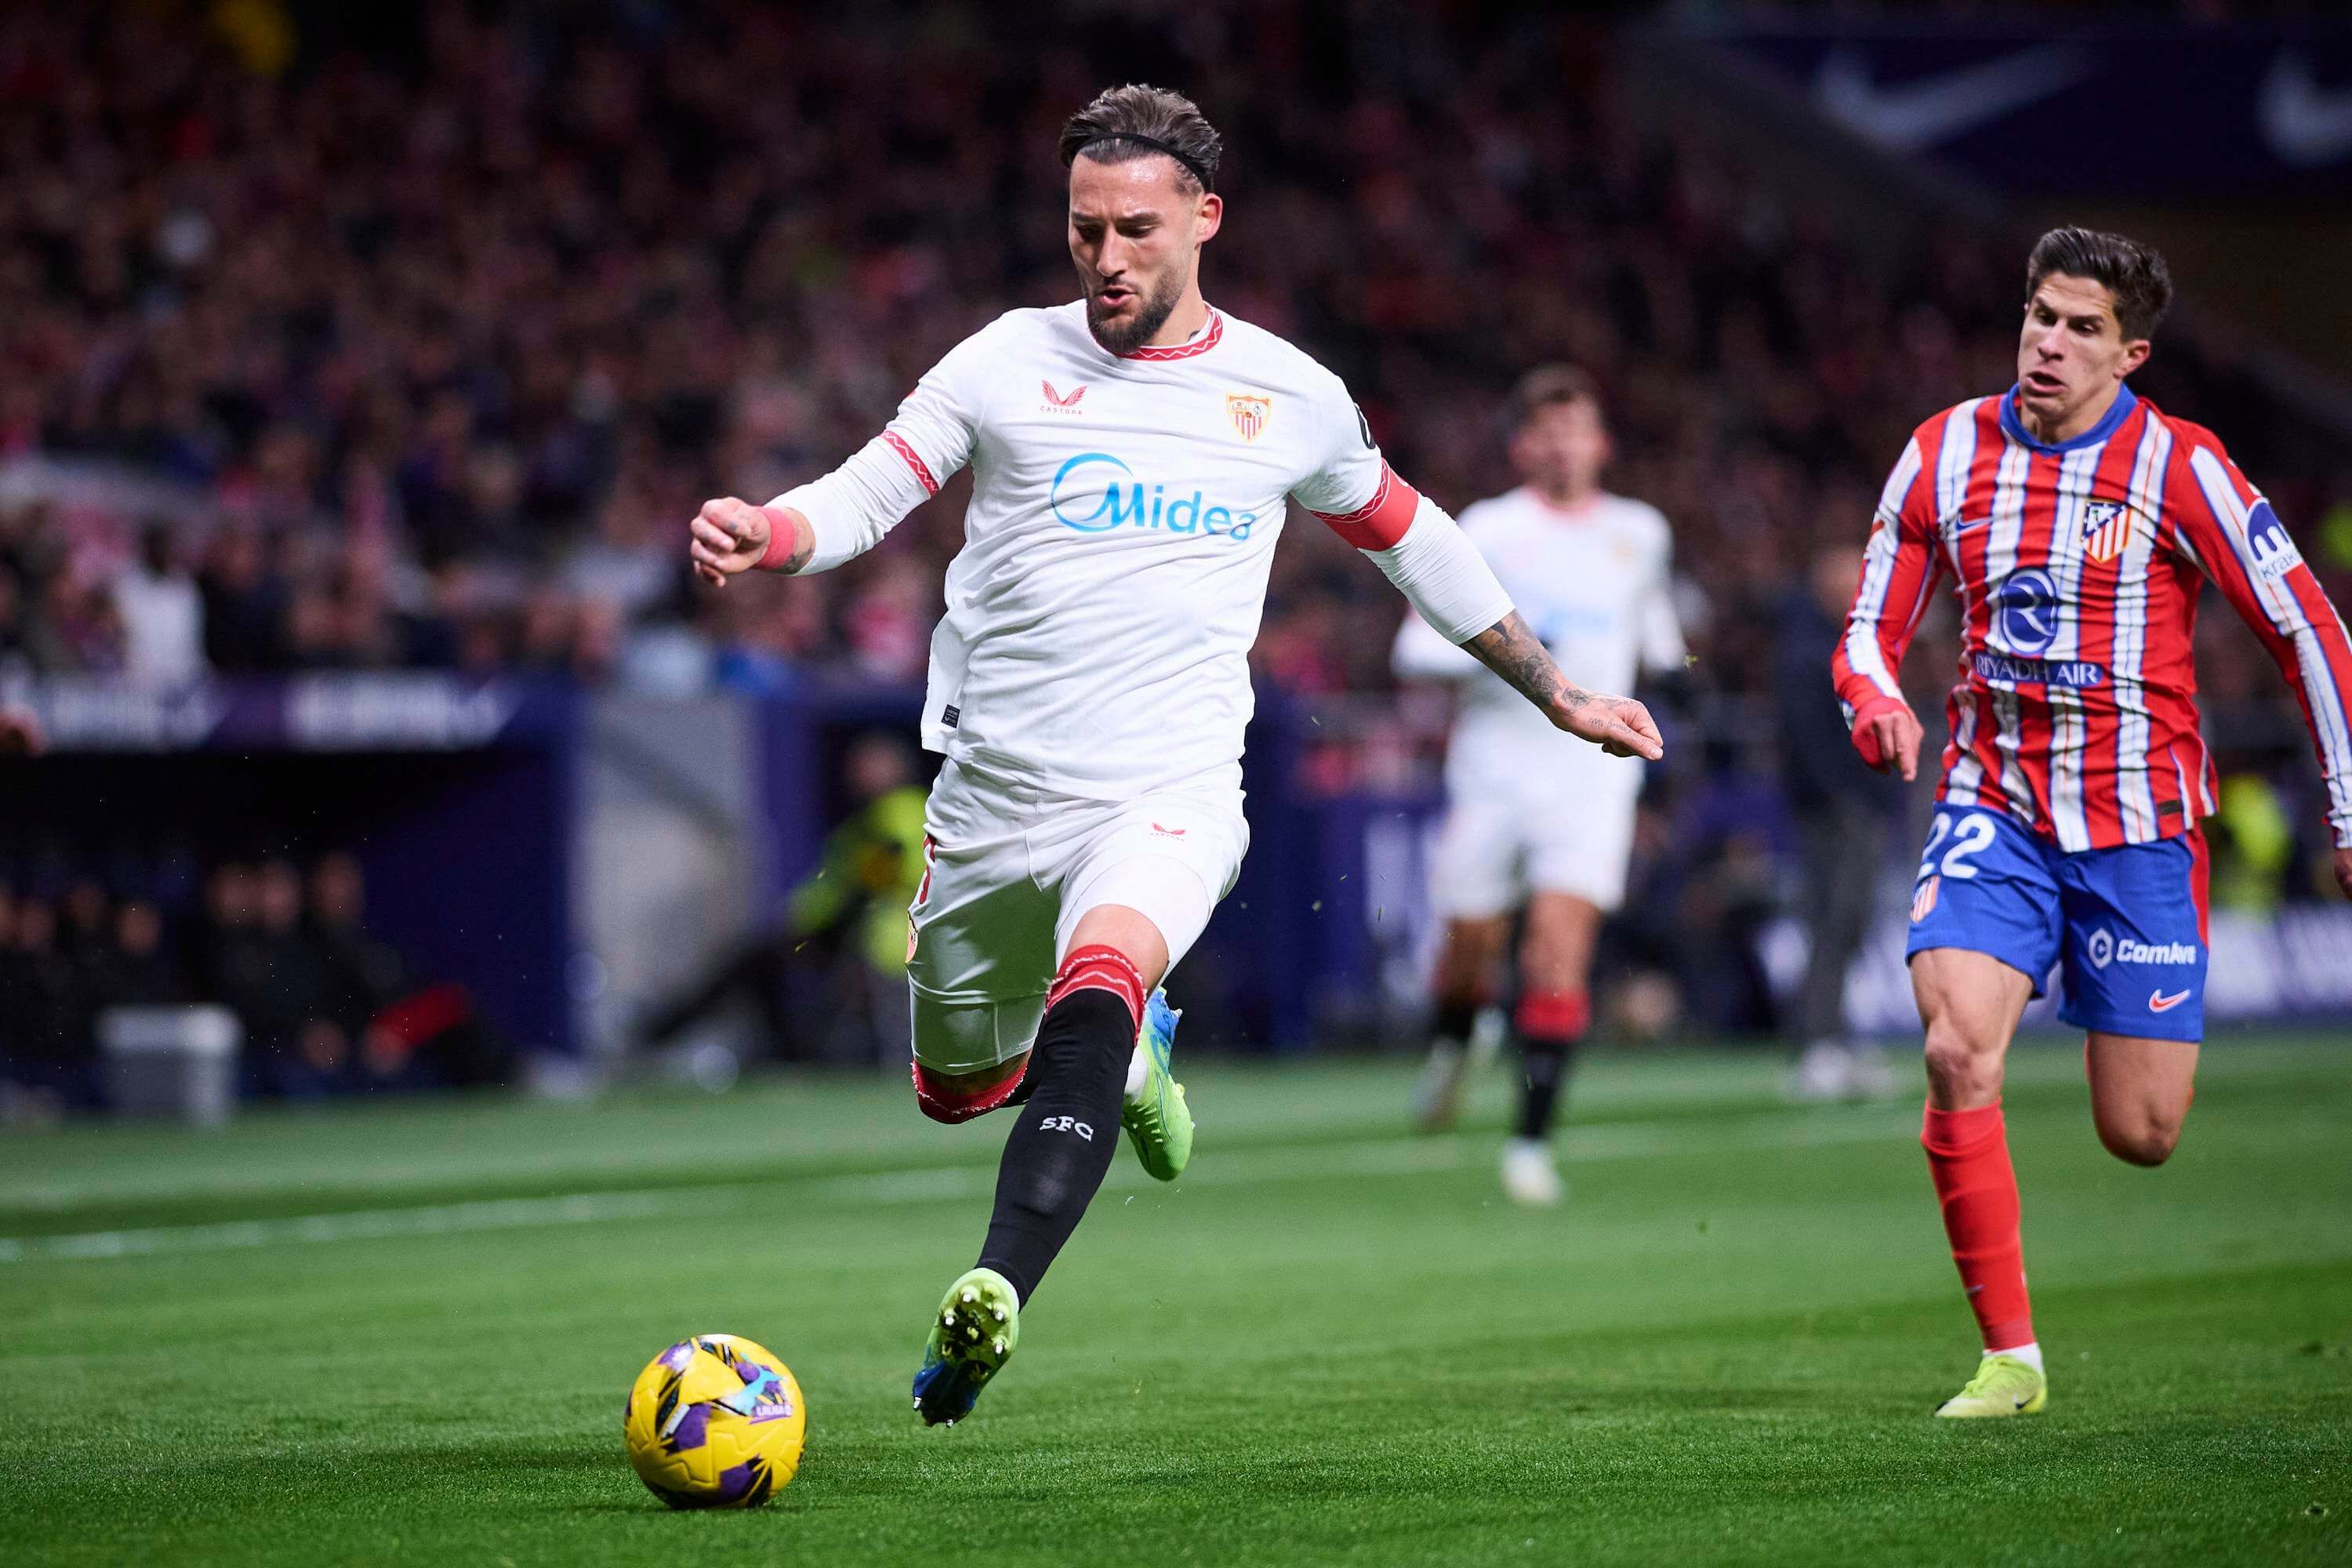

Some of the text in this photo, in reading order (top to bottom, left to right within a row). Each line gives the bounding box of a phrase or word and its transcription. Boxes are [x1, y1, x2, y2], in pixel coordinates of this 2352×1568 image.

[1051, 452, 1257, 540] Midea
[1976, 653, 2099, 685] RIYADH AIR
[1917, 812, 1996, 879] 22
[1039, 1116, 1094, 1142] SFC
